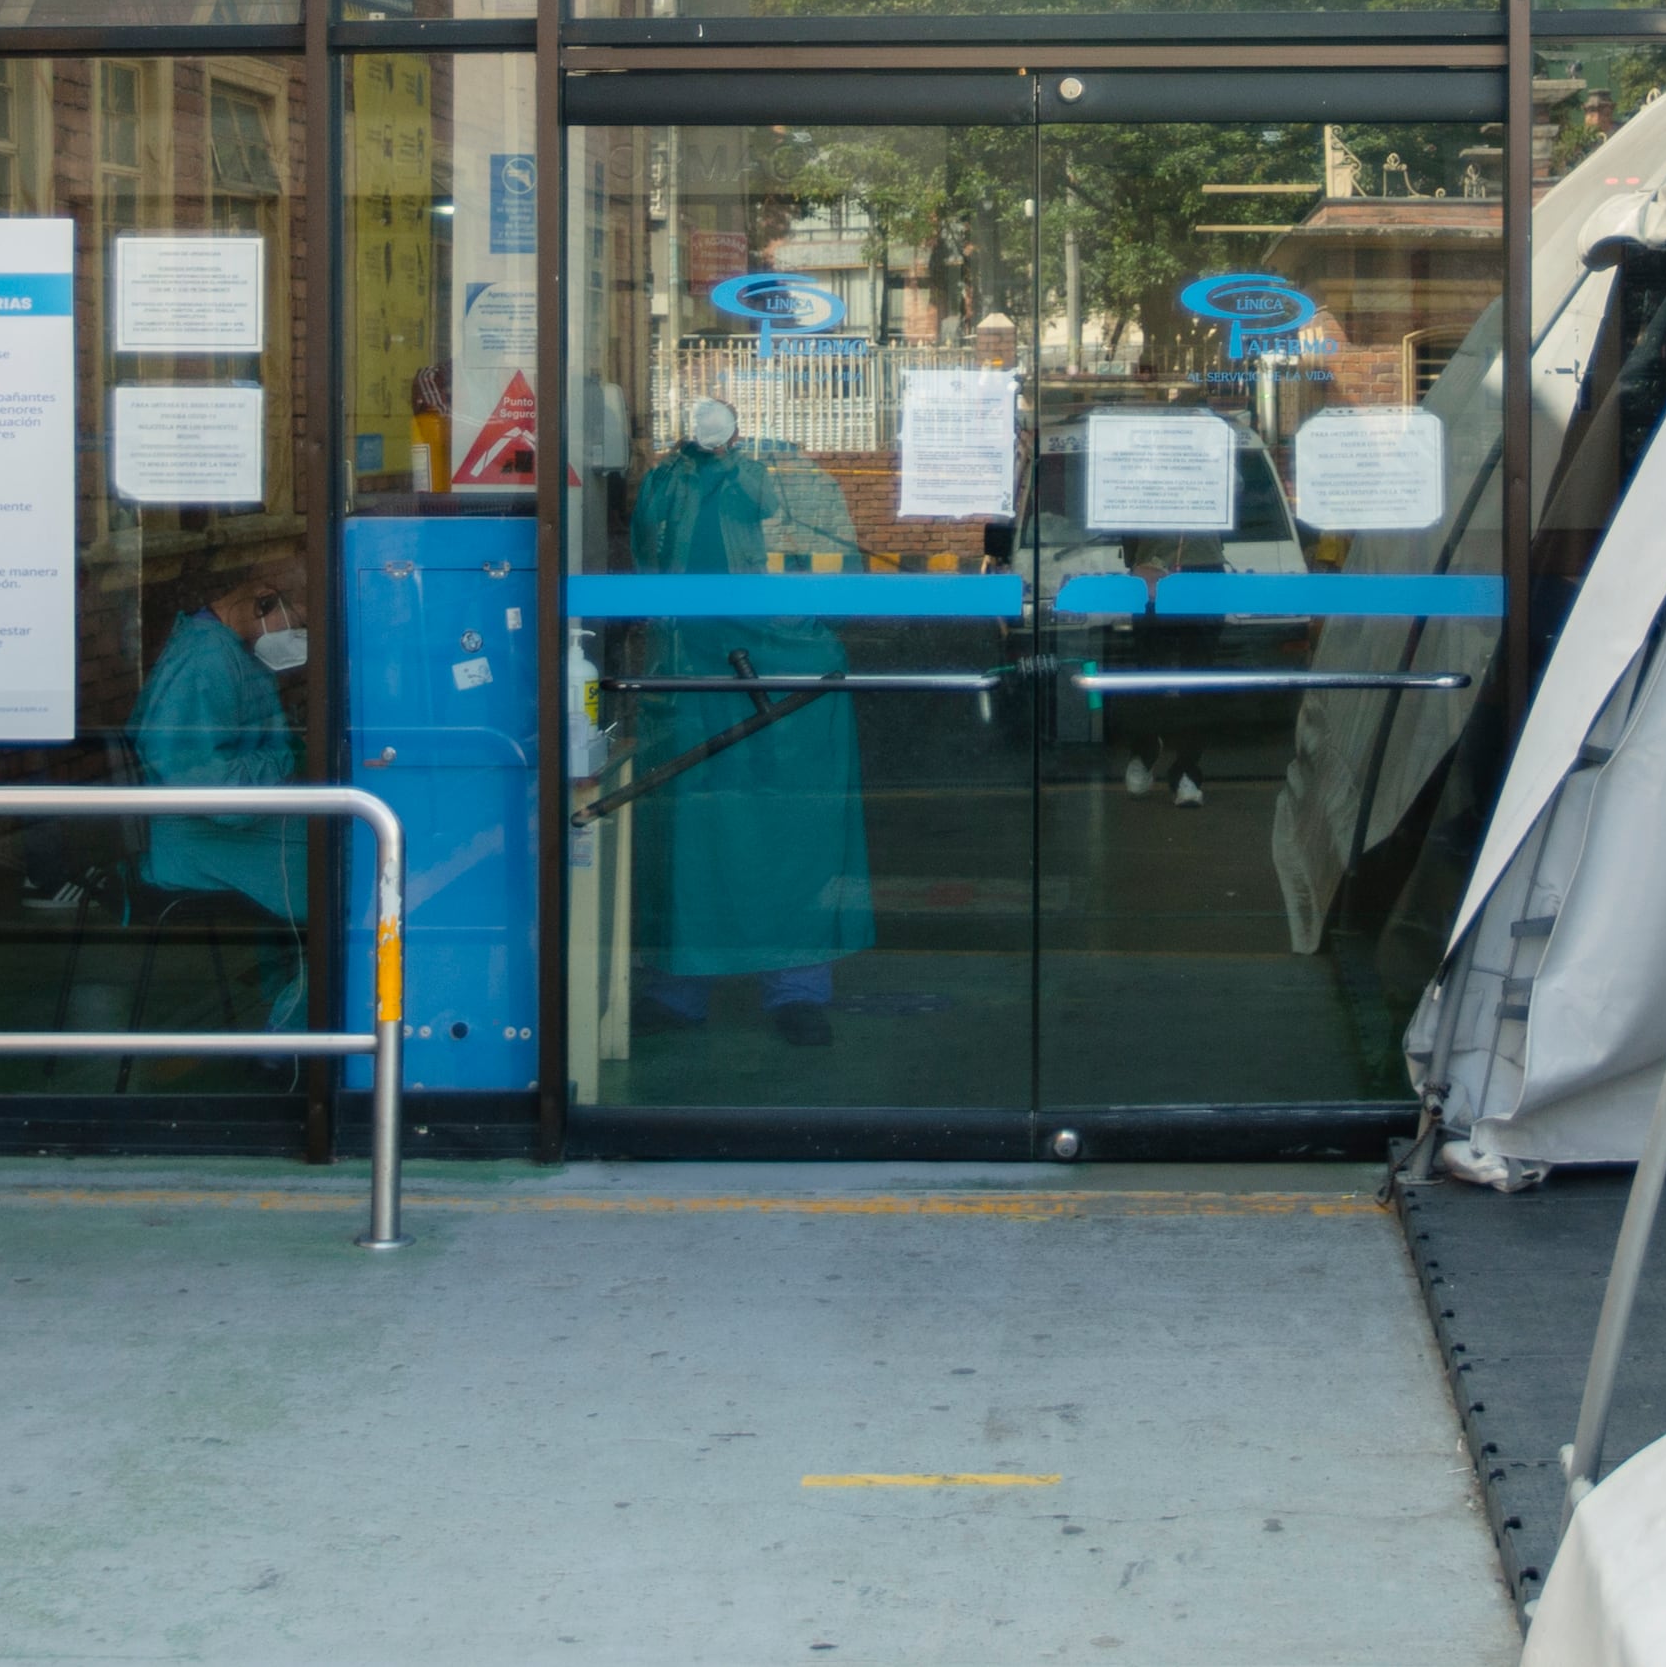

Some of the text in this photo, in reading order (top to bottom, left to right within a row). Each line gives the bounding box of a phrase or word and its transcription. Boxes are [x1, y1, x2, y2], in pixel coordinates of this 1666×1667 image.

[1187, 371, 1203, 383] AL
[1285, 371, 1301, 382] LA
[1305, 370, 1335, 381] VIDA
[503, 396, 534, 407] Punto
[499, 407, 536, 420] Seguro
